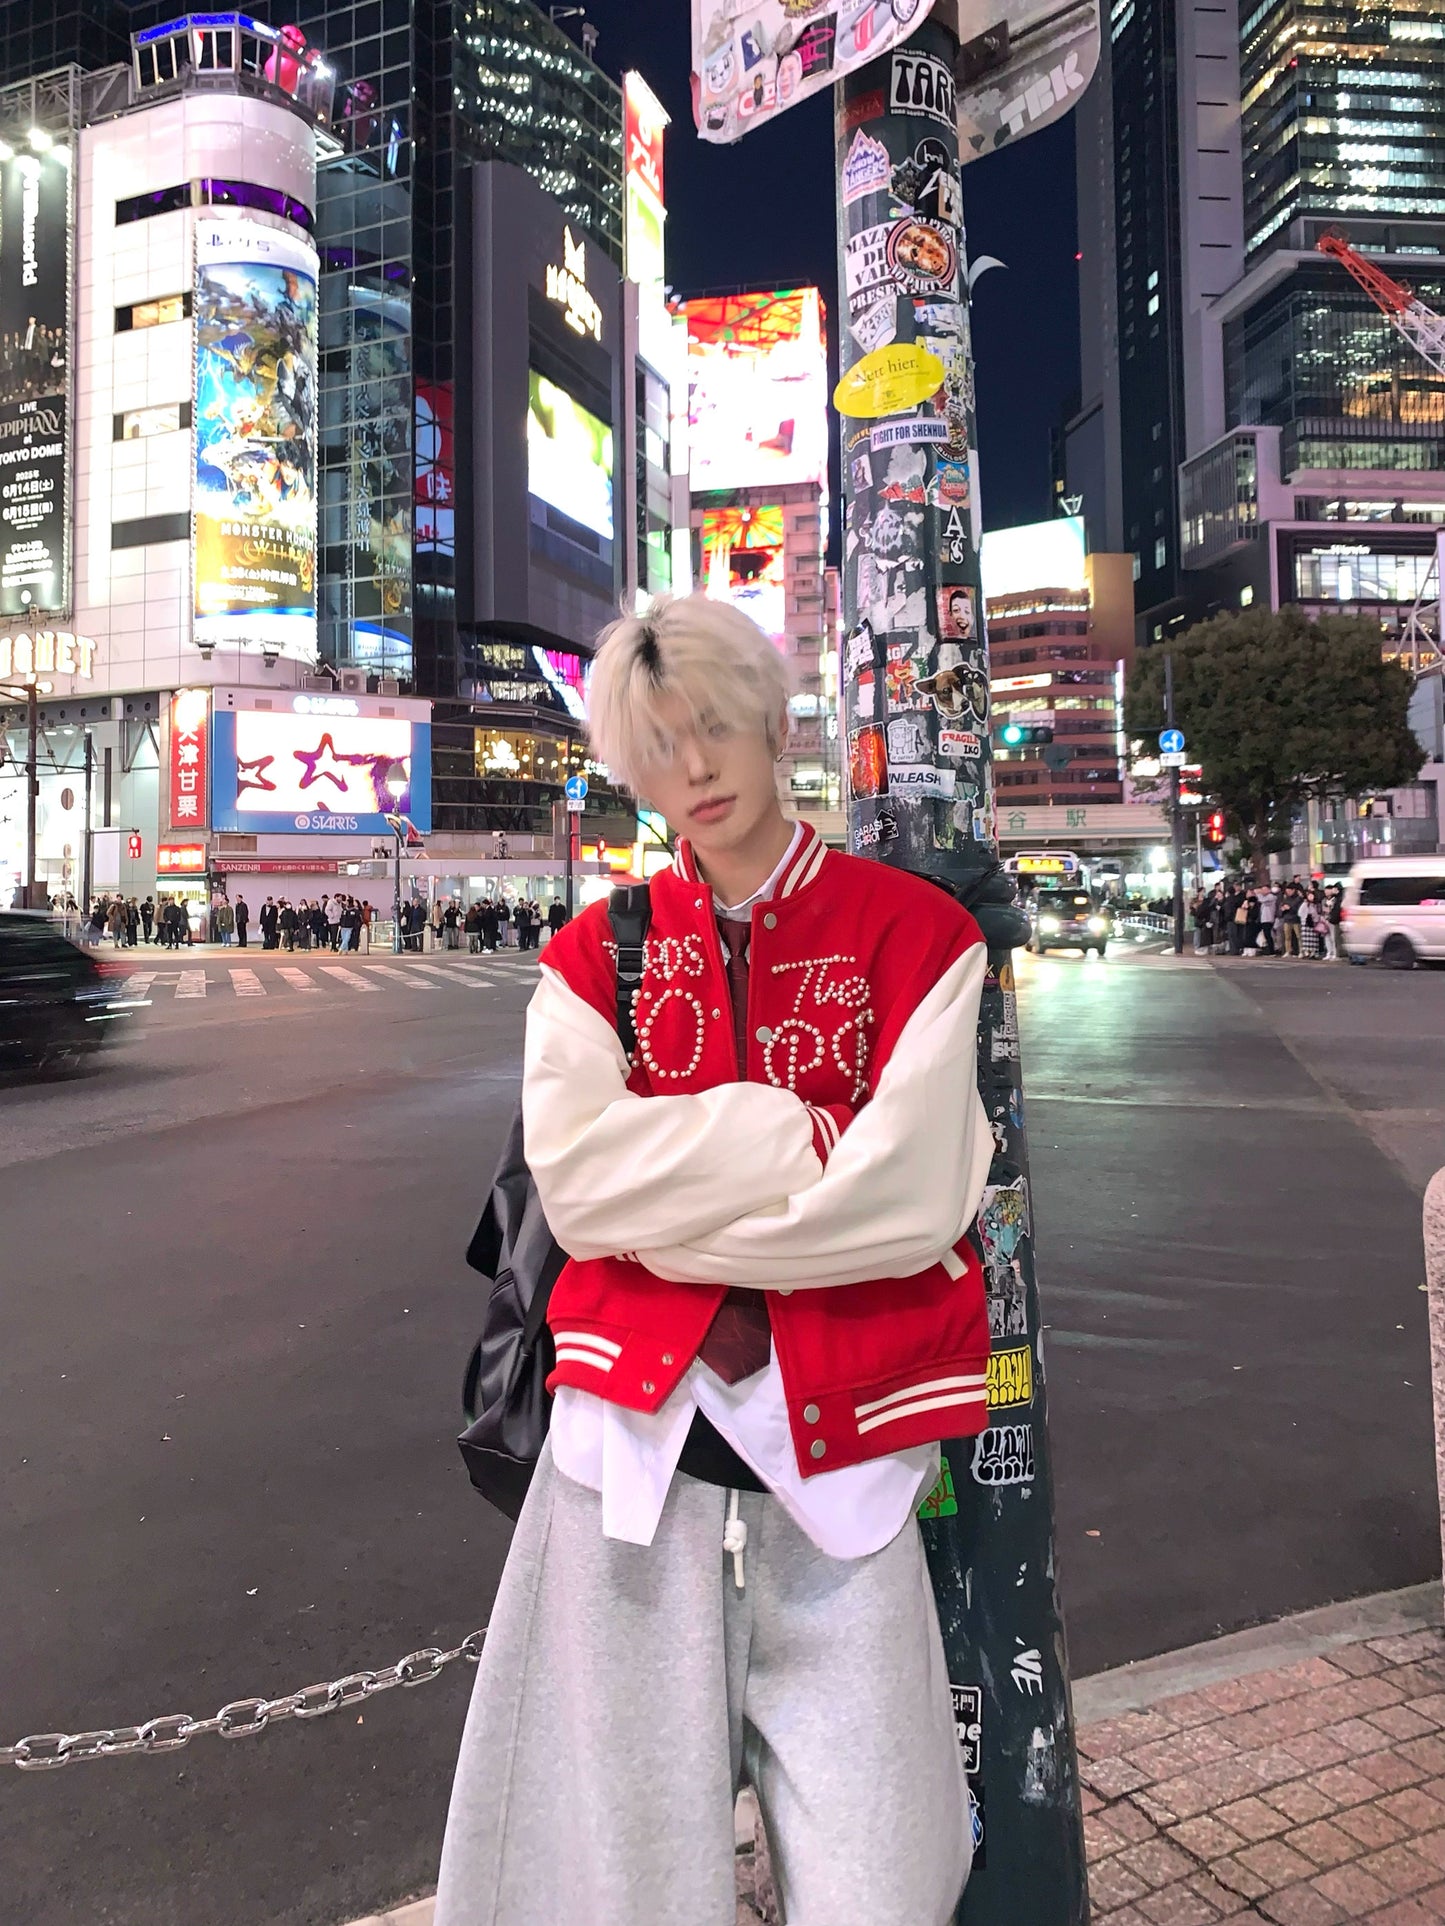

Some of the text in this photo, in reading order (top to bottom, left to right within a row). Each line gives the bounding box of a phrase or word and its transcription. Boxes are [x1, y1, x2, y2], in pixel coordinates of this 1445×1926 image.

[855, 358, 919, 382] Nett hier.
[19, 400, 38, 414] LIVE
[23, 433, 33, 445] at
[873, 427, 895, 446] FIGHT
[895, 425, 911, 440] FOR
[912, 423, 948, 439] SHENHUA
[31, 442, 63, 460] DOME
[220, 521, 284, 542] MONSTER
[941, 733, 979, 745] FRAGILE
[854, 818, 883, 839] GARASI
[220, 863, 261, 872] SANZENRI
